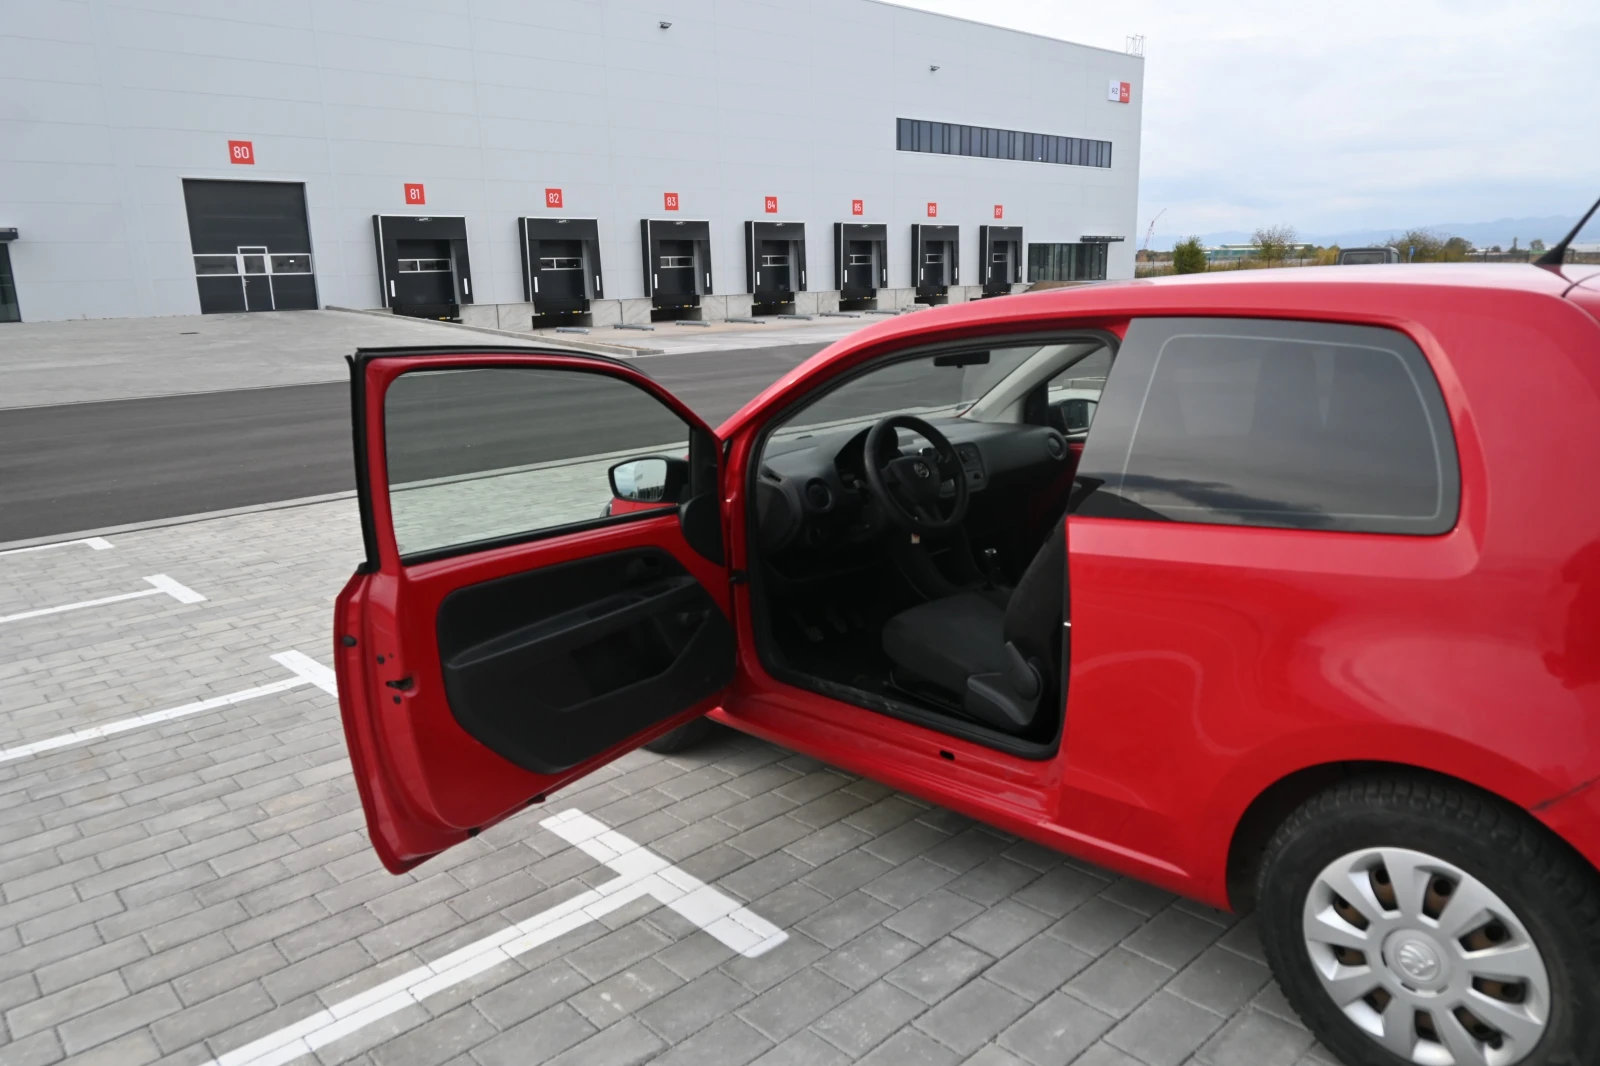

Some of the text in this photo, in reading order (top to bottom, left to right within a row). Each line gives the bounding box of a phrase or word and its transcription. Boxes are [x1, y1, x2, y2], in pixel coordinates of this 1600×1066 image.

[233, 145, 250, 159] 80
[410, 188, 420, 200] 81
[549, 193, 559, 204] 82
[667, 197, 676, 207] 83
[767, 200, 776, 209] 84
[854, 203, 861, 212] 85
